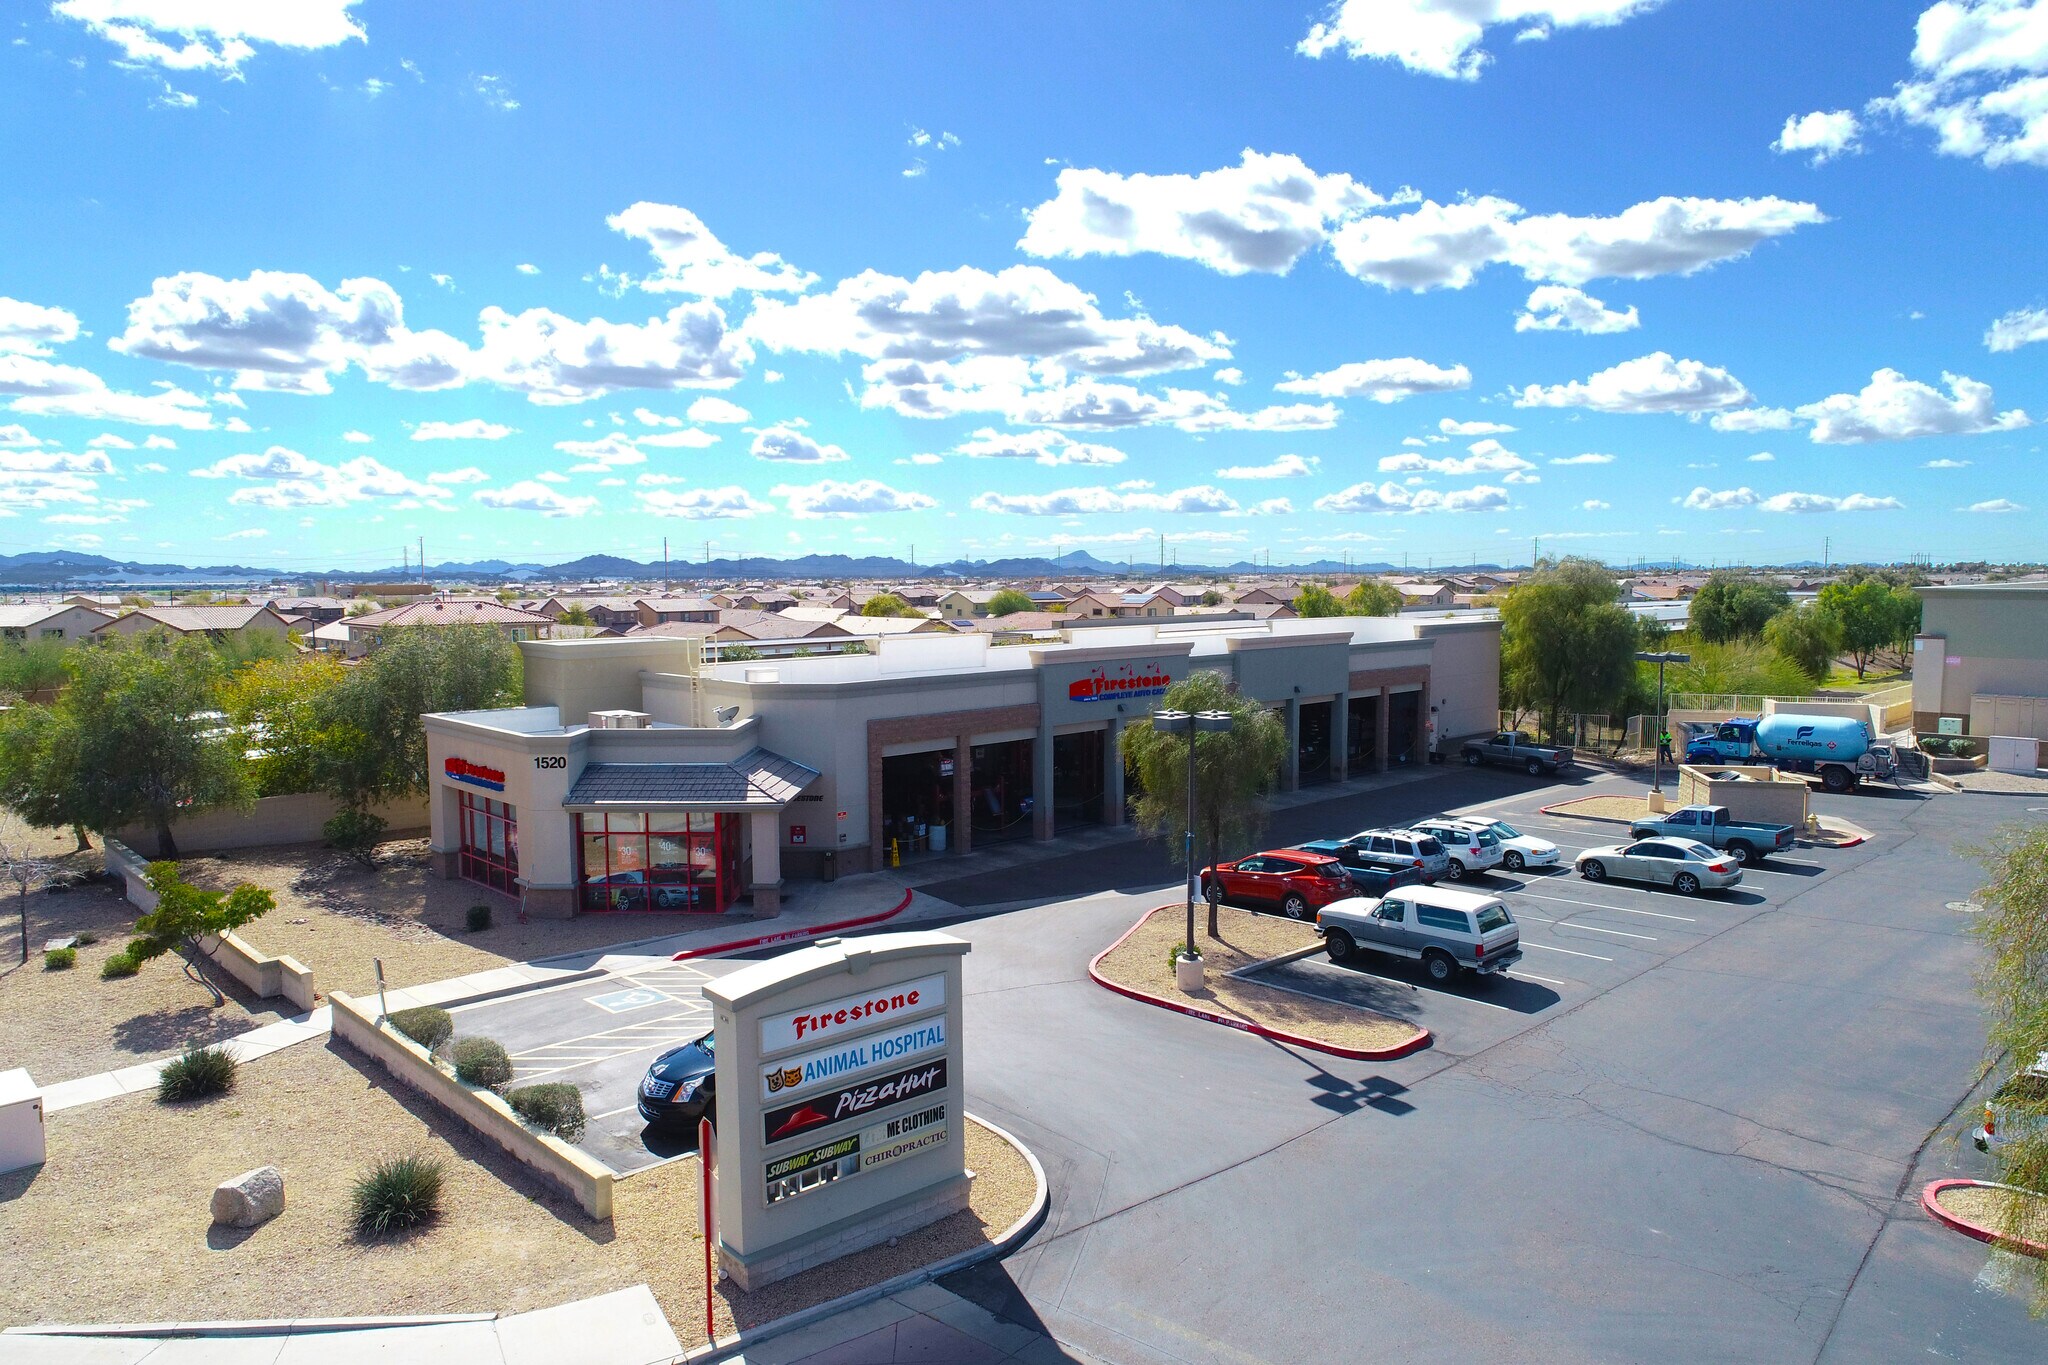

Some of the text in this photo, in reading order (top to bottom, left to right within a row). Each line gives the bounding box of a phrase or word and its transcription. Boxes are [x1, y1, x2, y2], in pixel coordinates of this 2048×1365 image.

[1094, 674, 1171, 695] Firestone
[1133, 689, 1151, 698] AUTO
[1787, 738, 1822, 748] Ferrellgas
[534, 756, 567, 769] 1520
[792, 990, 920, 1040] Firestone
[804, 1026, 944, 1082] ANIMAL HOSPITAL
[887, 1120, 901, 1139] ME
[902, 1105, 945, 1133] CLOTHING
[767, 1137, 858, 1178] SUBWAY SUBWAY
[865, 1130, 947, 1166] CHIROPRACTIC
